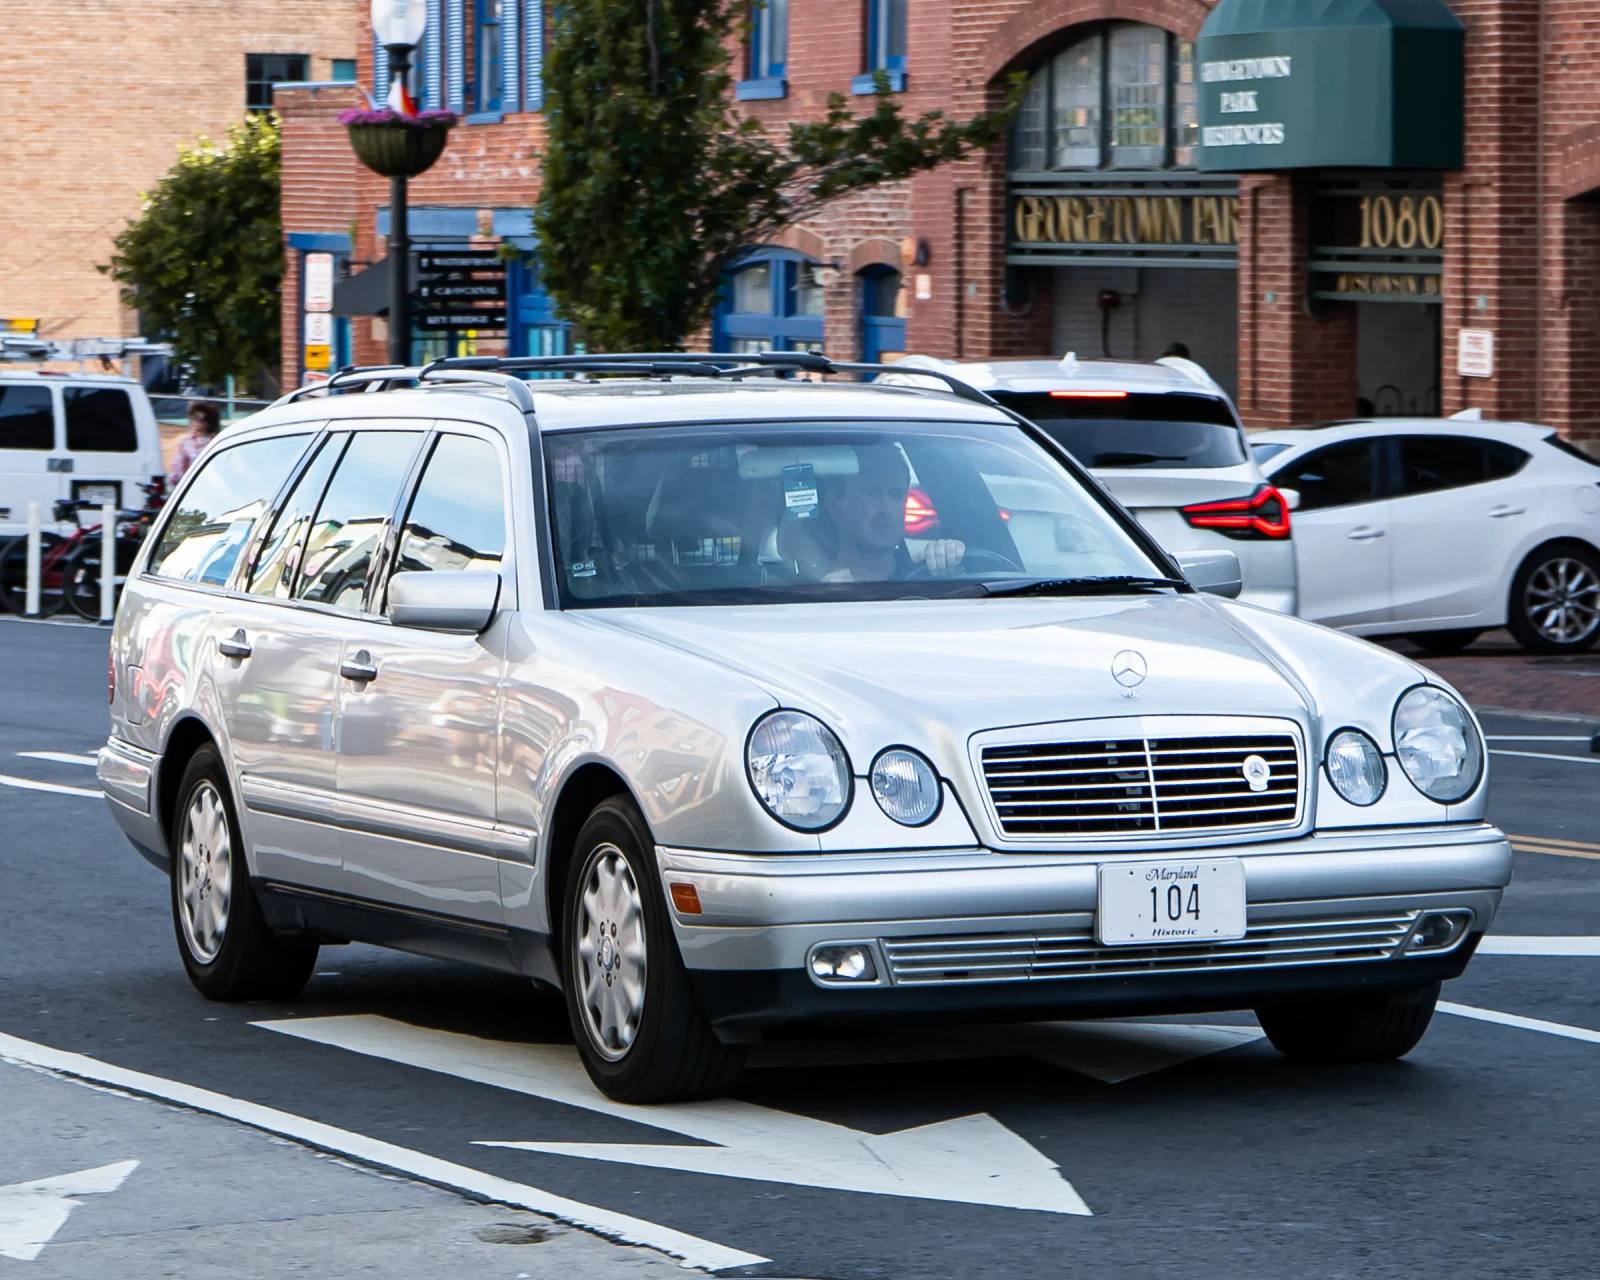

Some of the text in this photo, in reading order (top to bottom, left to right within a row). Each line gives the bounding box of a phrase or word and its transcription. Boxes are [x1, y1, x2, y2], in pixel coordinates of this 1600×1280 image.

[1015, 196, 1182, 242] GEORGETOWN
[1360, 195, 1441, 248] 1080
[1145, 866, 1200, 883] Maryland
[1150, 883, 1200, 923] 104
[1152, 927, 1198, 937] Historic
